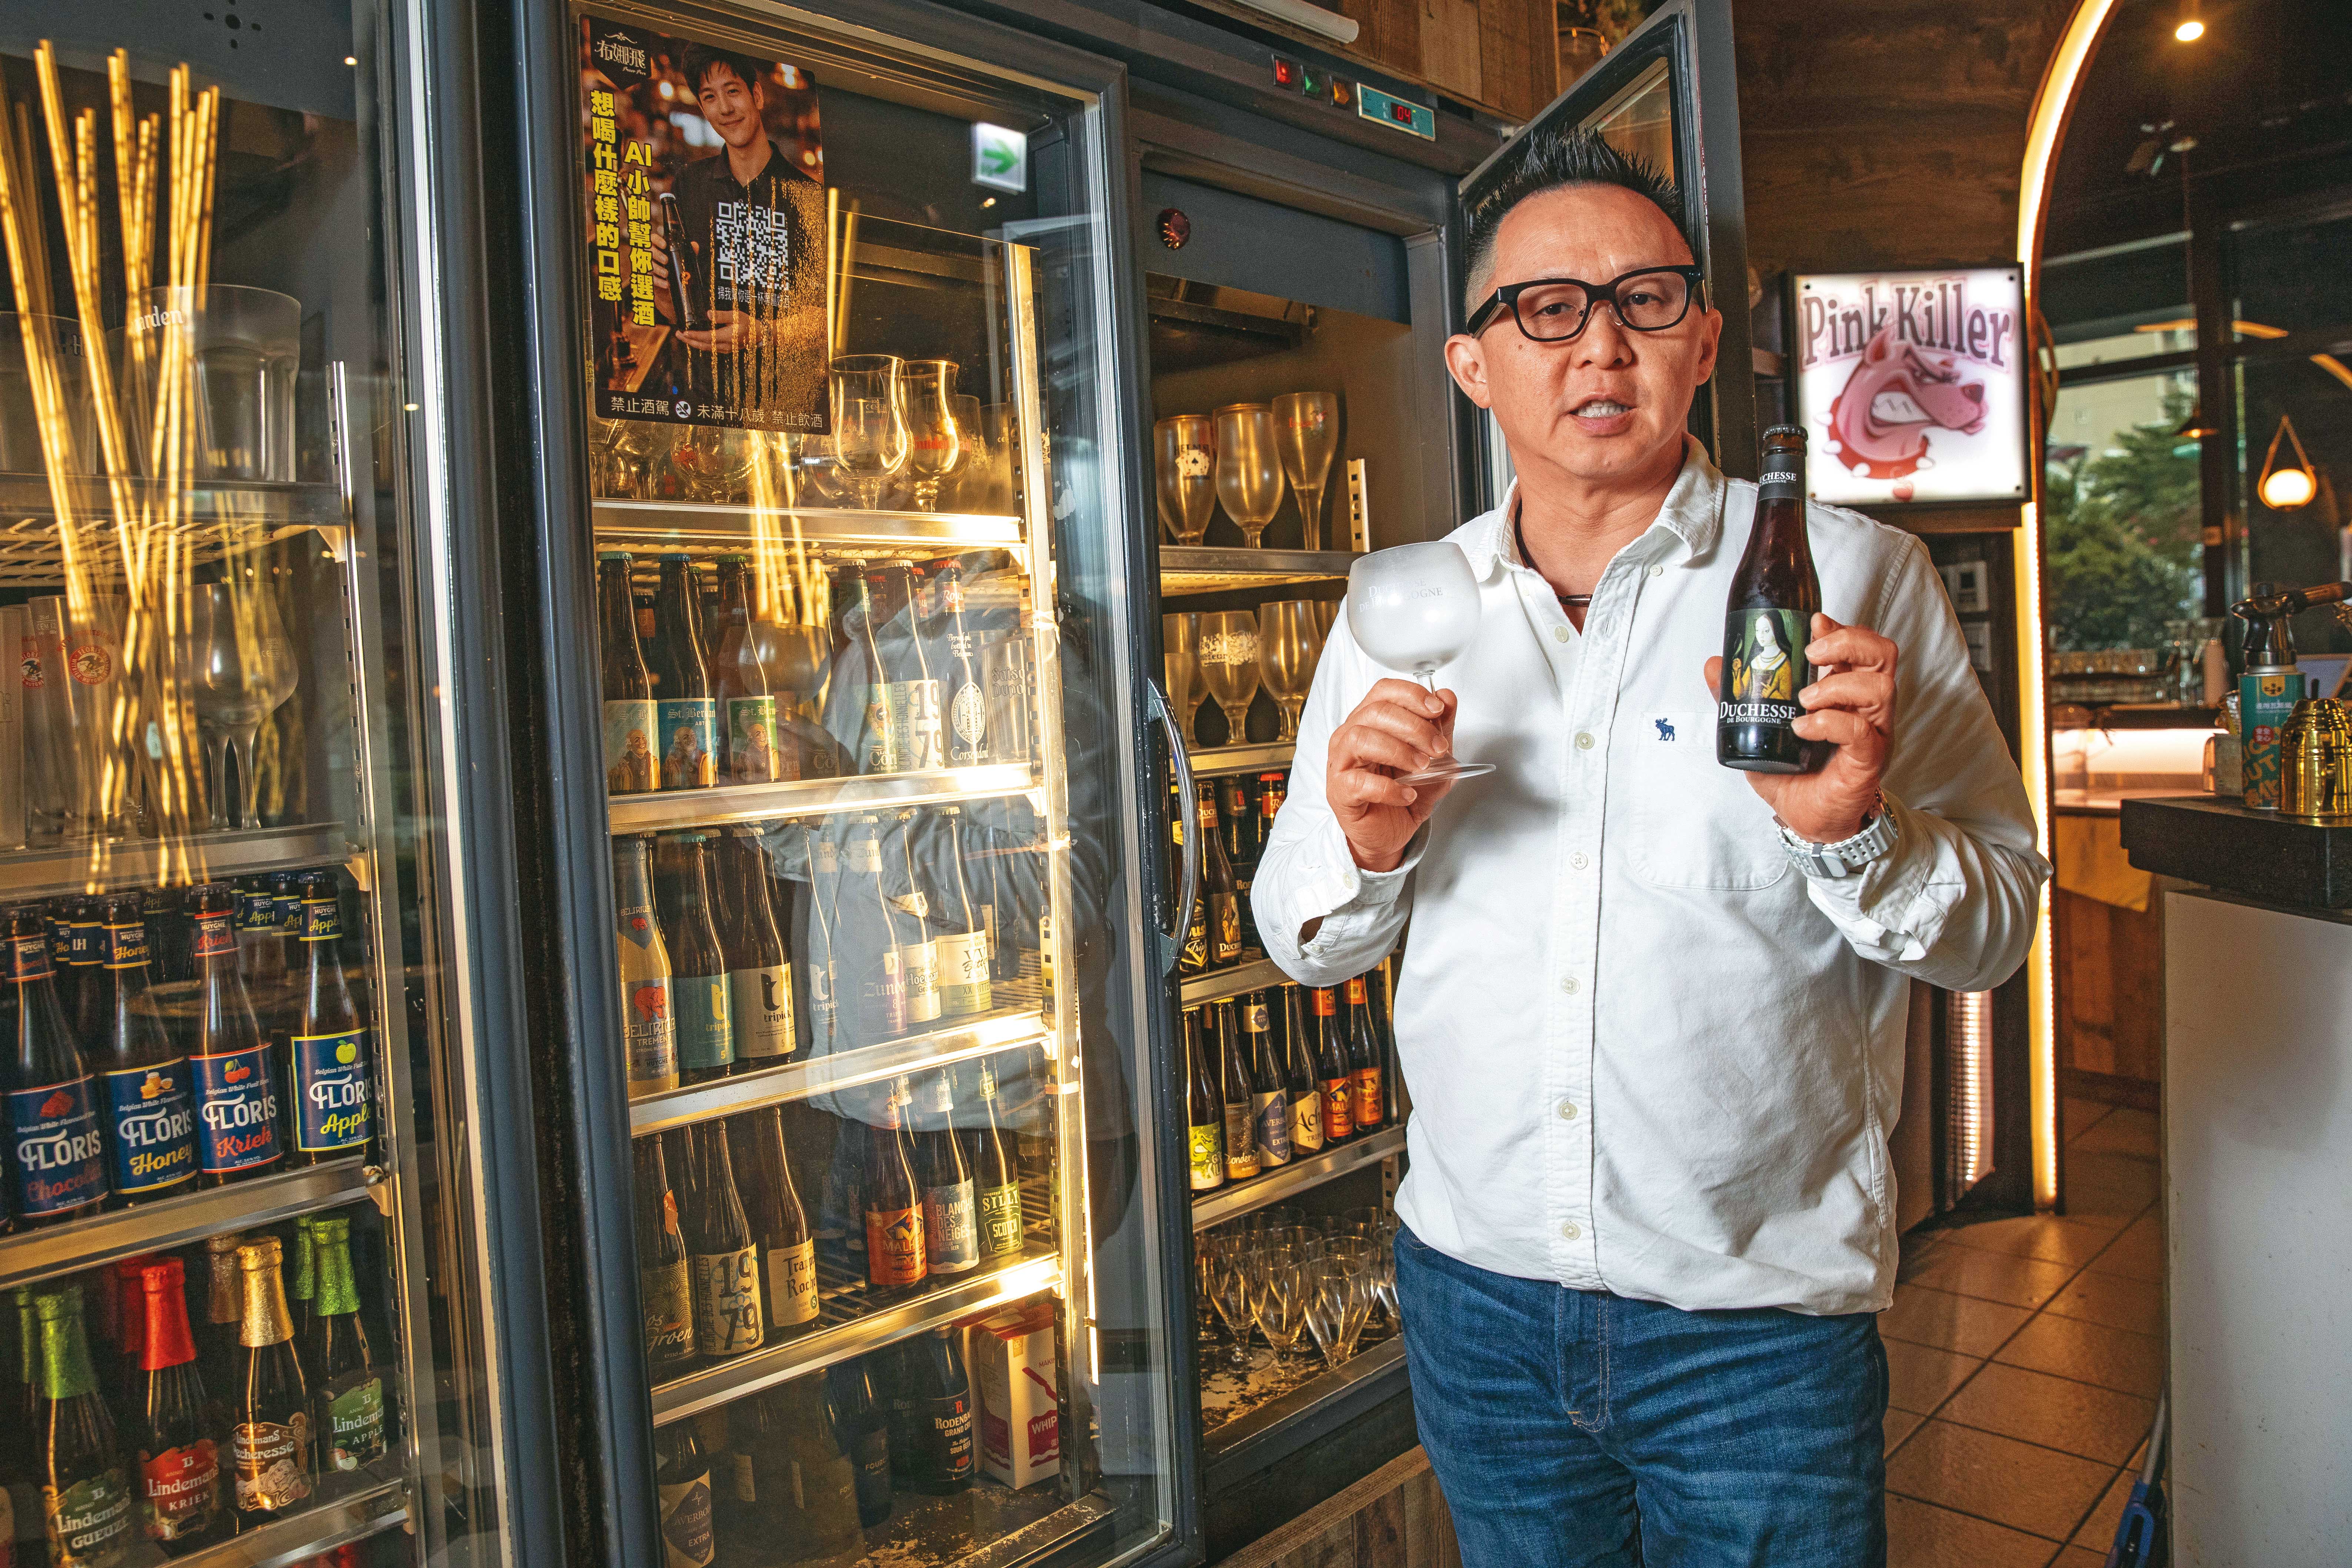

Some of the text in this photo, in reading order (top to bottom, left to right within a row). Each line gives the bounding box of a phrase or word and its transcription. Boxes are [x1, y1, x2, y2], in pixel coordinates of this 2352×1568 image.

[594, 40, 646, 69] 布娜飛
[591, 90, 622, 302] 想喝什麼樣的口感
[624, 140, 655, 326] AI小帥幫你選酒
[1804, 283, 2010, 367] Pink Killer
[611, 396, 823, 428] 禁止酒駕 未滿十八歲 禁止飲酒
[915, 682, 940, 720] 19
[1719, 700, 1796, 720] DUCHESSE
[668, 709, 684, 719] St.
[1735, 714, 1782, 725] BOURGOGNE
[915, 729, 945, 769] 79
[950, 742, 989, 761] Corsedonk
[620, 905, 652, 917] DELIRIUM
[201, 922, 226, 930] HUYGHE
[963, 986, 973, 996] XX
[893, 999, 897, 1009] 8
[720, 1050, 726, 1059] 5
[119, 1103, 141, 1112] Belgian
[202, 1093, 277, 1131] FLORIS
[119, 1106, 193, 1147] FLORIS
[17, 1128, 101, 1171] FLORIS
[216, 1125, 273, 1158] Kriek
[129, 1142, 193, 1176] Honey
[936, 1196, 973, 1217] BLANCHE
[982, 1189, 1019, 1212] SILLY
[937, 1215, 955, 1229] DES
[992, 1218, 1018, 1238] SCOTCH
[938, 1224, 971, 1242] NEIGES
[719, 1251, 754, 1298] 19
[812, 1298, 816, 1306] 8
[719, 1302, 759, 1351] 79
[352, 1425, 383, 1445] APPLE
[945, 1424, 964, 1437] GRAND
[950, 1446, 963, 1455] SOUR
[169, 1491, 210, 1512] KRIEK
[688, 1531, 710, 1547] EXTRA
